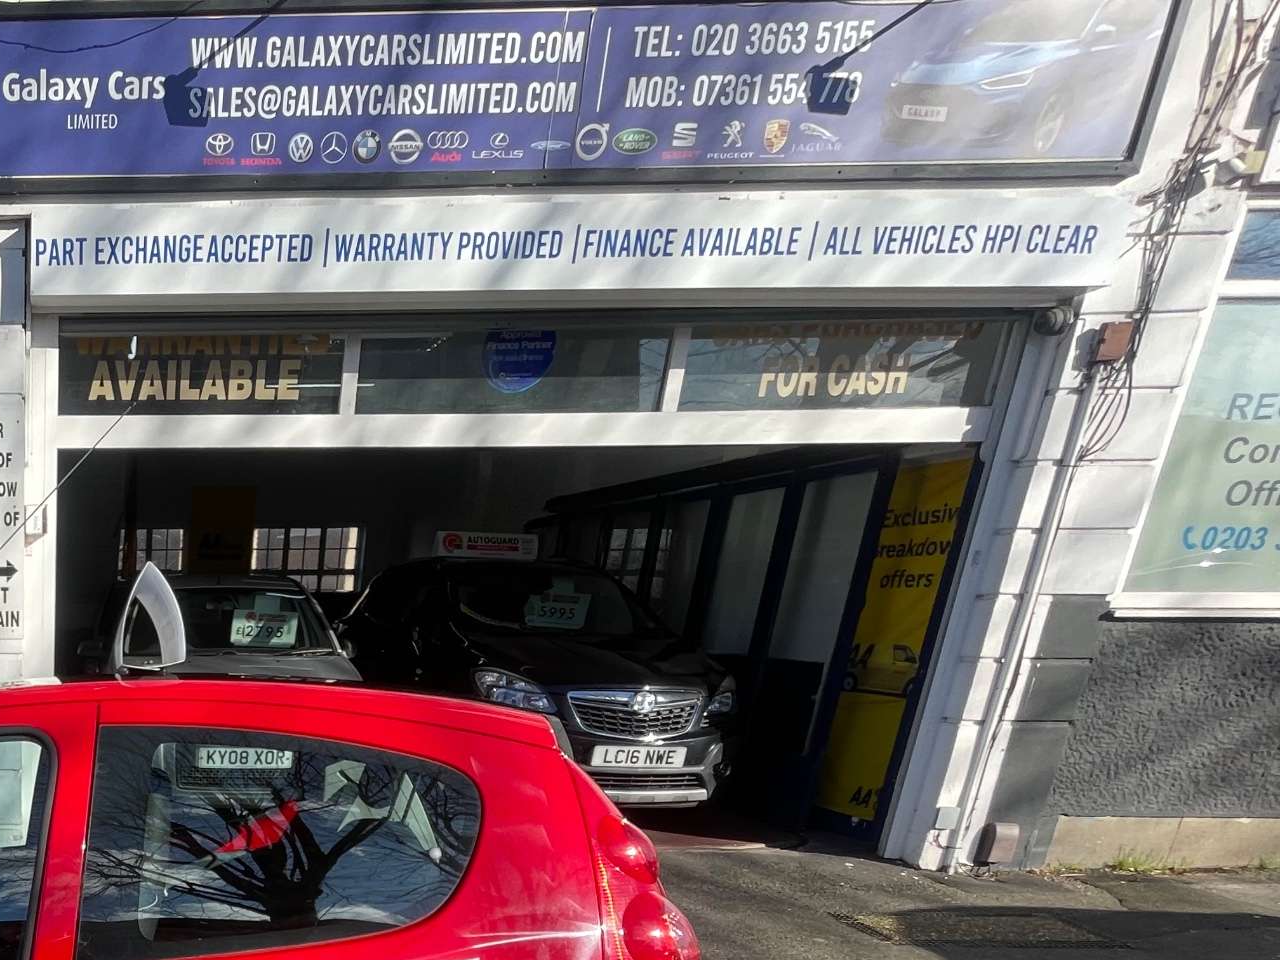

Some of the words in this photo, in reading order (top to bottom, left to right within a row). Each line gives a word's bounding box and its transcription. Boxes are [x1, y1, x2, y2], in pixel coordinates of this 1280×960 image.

[633, 26, 682, 58] TEL:
[691, 24, 738, 56] 020
[745, 21, 807, 55] 3663
[814, 19, 876, 54] 5155
[190, 30, 585, 69] WWW.GALAXYCARSLIMITED.COM
[2, 69, 99, 107] Galaxy
[107, 70, 166, 101] Cars
[624, 75, 685, 108] MOB:
[692, 74, 761, 107] 07361
[767, 73, 812, 105] 554
[821, 71, 864, 104] 778
[187, 81, 577, 120] SALES@GALAXYCARSLIMITED.COM
[66, 114, 118, 130] LIMITED
[622, 133, 646, 141] LAND
[623, 141, 650, 150] ROVER
[471, 150, 524, 159] LEXUS
[706, 151, 754, 159] PEUGEOT
[791, 143, 842, 152] JAGUAR
[431, 152, 461, 162] Audi
[35, 237, 87, 267] PART
[94, 235, 205, 265] EXCHANGE
[206, 234, 313, 263] ACCEPTED
[334, 231, 454, 262] WARRANTY
[457, 229, 563, 261] PROVIDED
[582, 228, 678, 259] FINANCE
[681, 227, 802, 257] AVAILABLE
[824, 226, 863, 256] ALL
[873, 225, 976, 255] VEHICLES
[981, 224, 1021, 254] HPI
[1025, 224, 1098, 254] CLEAR
[88, 359, 302, 401] AVAILABLE
[757, 353, 819, 397] FOR
[826, 351, 911, 396] CASH
[1225, 392, 1280, 420] RE
[3, 511, 20, 526] OF
[466, 535, 520, 545] AUTOGUARD
[1201, 525, 1269, 550] 0203
[879, 569, 935, 588] offers
[206, 749, 250, 765] KY08
[254, 750, 286, 765] XOR
[602, 748, 641, 764] LC16
[643, 749, 678, 765] NWE
